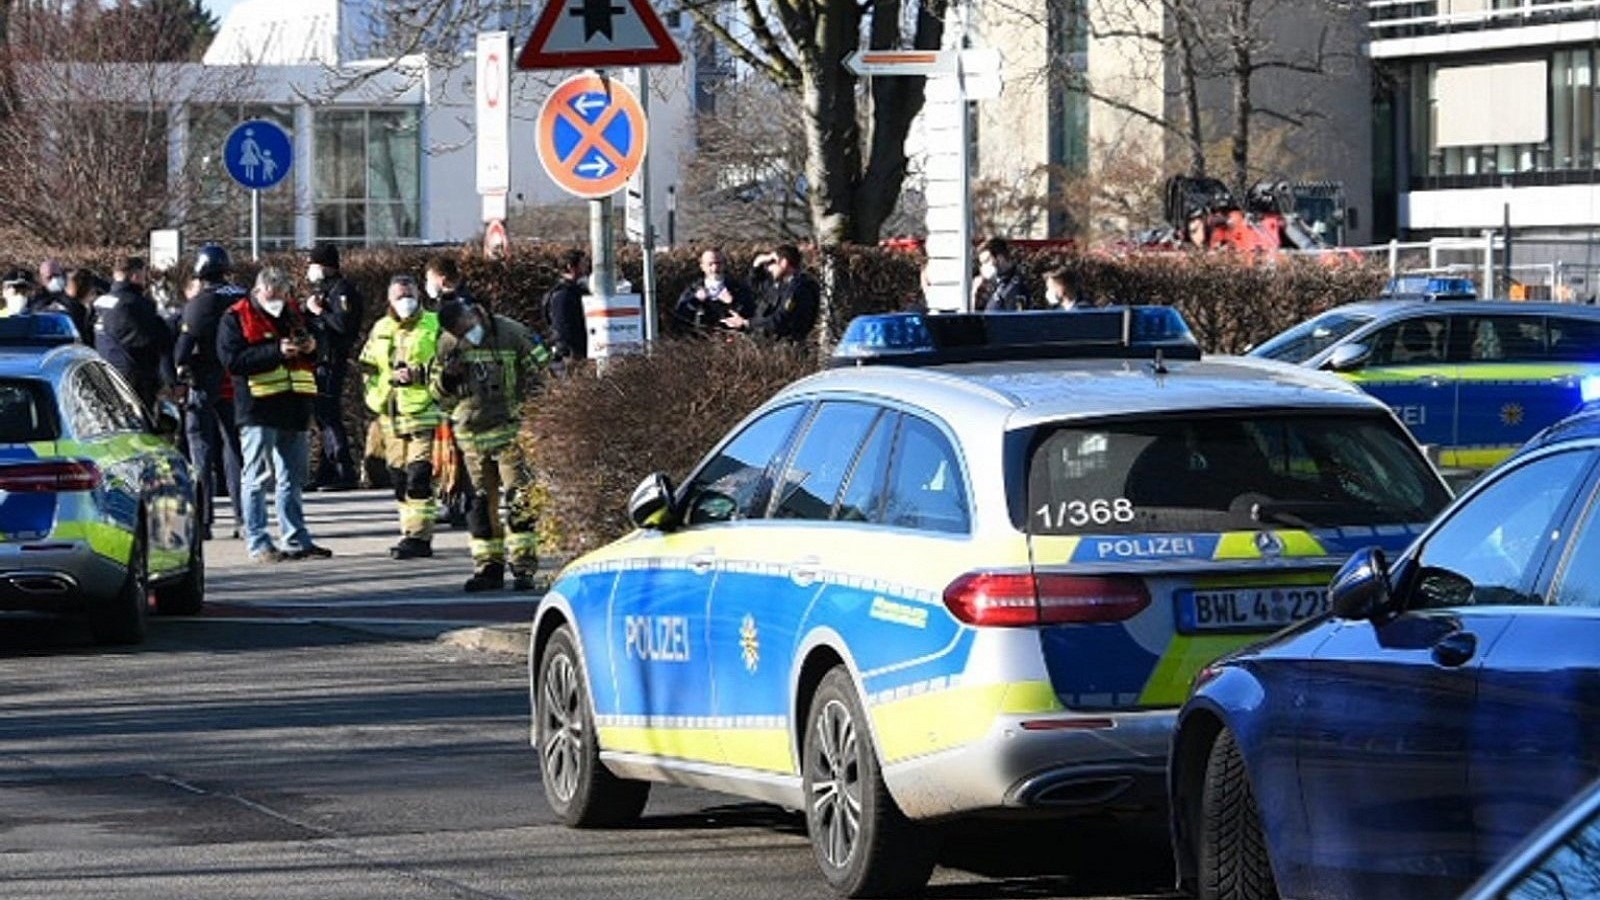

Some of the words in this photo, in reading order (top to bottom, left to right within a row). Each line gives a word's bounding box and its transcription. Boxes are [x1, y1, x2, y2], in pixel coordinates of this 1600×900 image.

[1036, 498, 1135, 528] 1/368
[1097, 537, 1195, 559] POLIZEI
[1195, 593, 1247, 623] BWL
[1253, 592, 1269, 621] 4
[625, 615, 690, 661] POLIZEI
